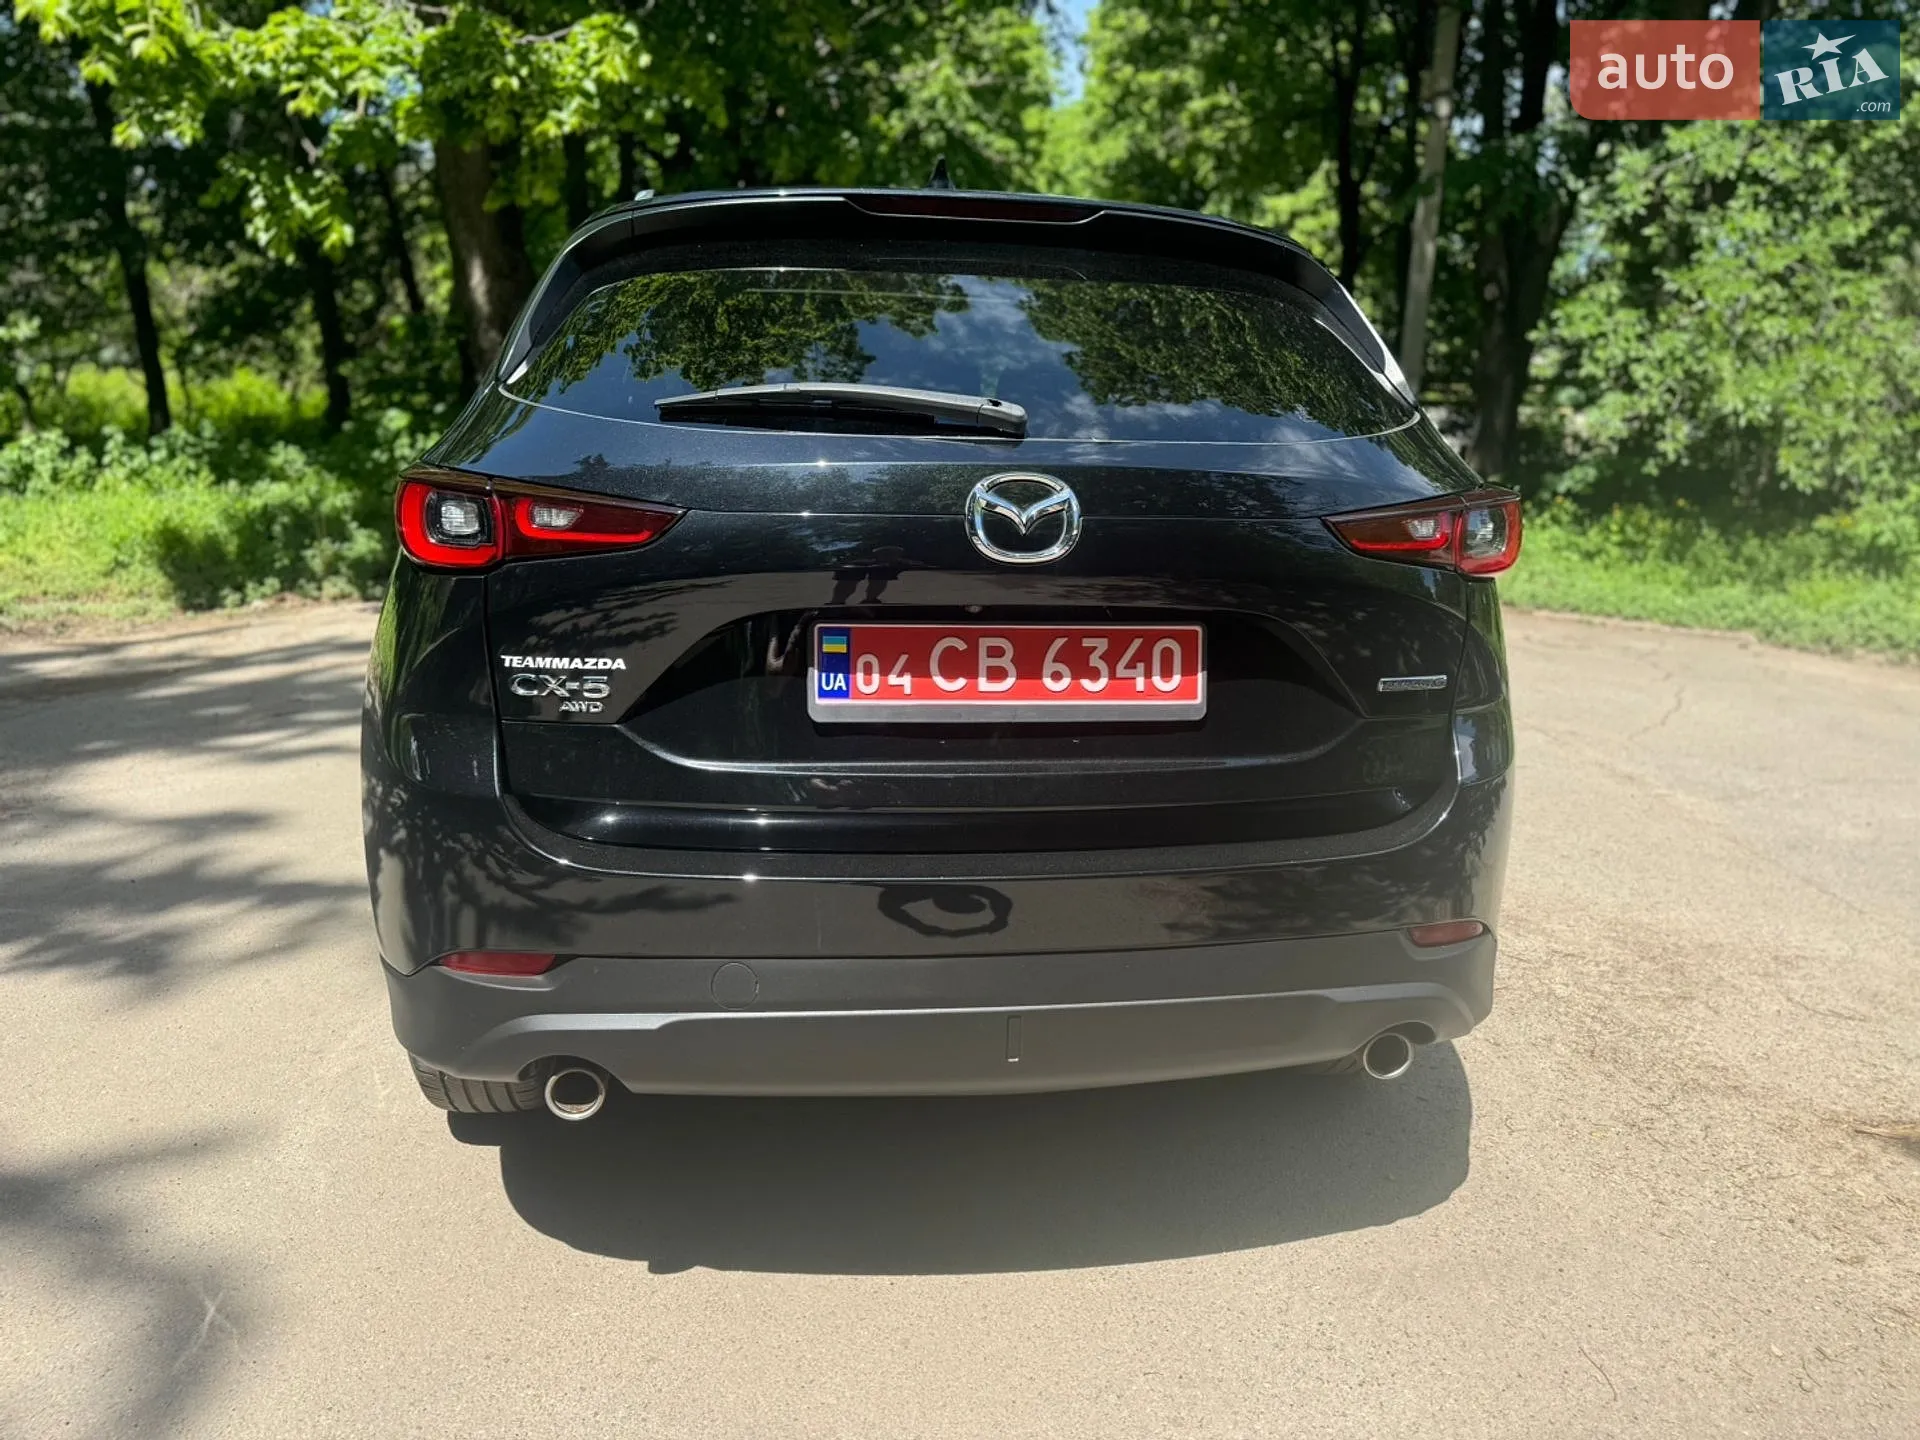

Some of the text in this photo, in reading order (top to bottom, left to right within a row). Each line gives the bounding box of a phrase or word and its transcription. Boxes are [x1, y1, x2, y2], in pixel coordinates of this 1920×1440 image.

[500, 655, 626, 670] TEAMMAZDA
[856, 637, 1182, 695] 04 CB 6340
[509, 673, 611, 698] CX-5
[821, 672, 847, 691] UA
[559, 701, 604, 713] AWD
